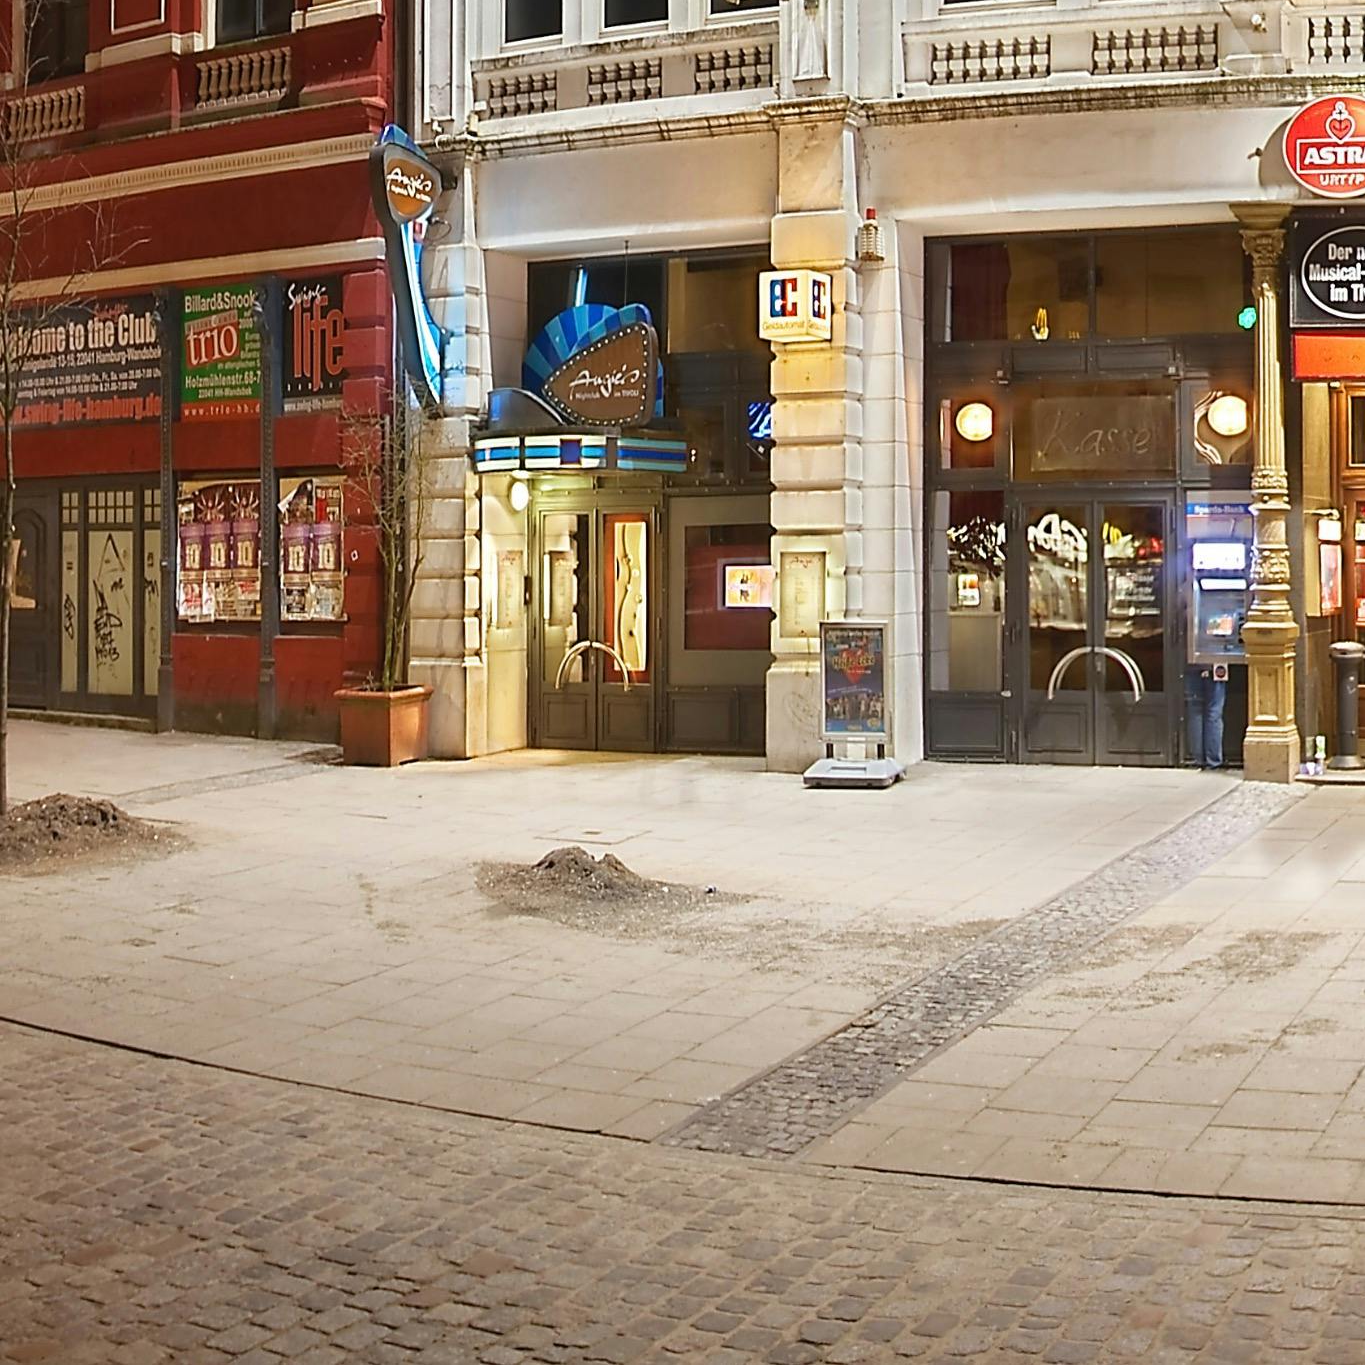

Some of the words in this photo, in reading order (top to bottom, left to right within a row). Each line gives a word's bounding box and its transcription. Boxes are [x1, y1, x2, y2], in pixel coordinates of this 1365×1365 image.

[1320, 173, 1365, 187] URTYP
[1328, 243, 1352, 260] Der
[1330, 284, 1348, 302] im
[69, 322, 85, 351] to
[88, 318, 115, 349] the
[118, 311, 157, 347] Club
[763, 320, 805, 330] Geldautomat
[186, 324, 239, 366] trio
[622, 389, 639, 397] TIVOLI
[1042, 411, 1150, 457] Kasse
